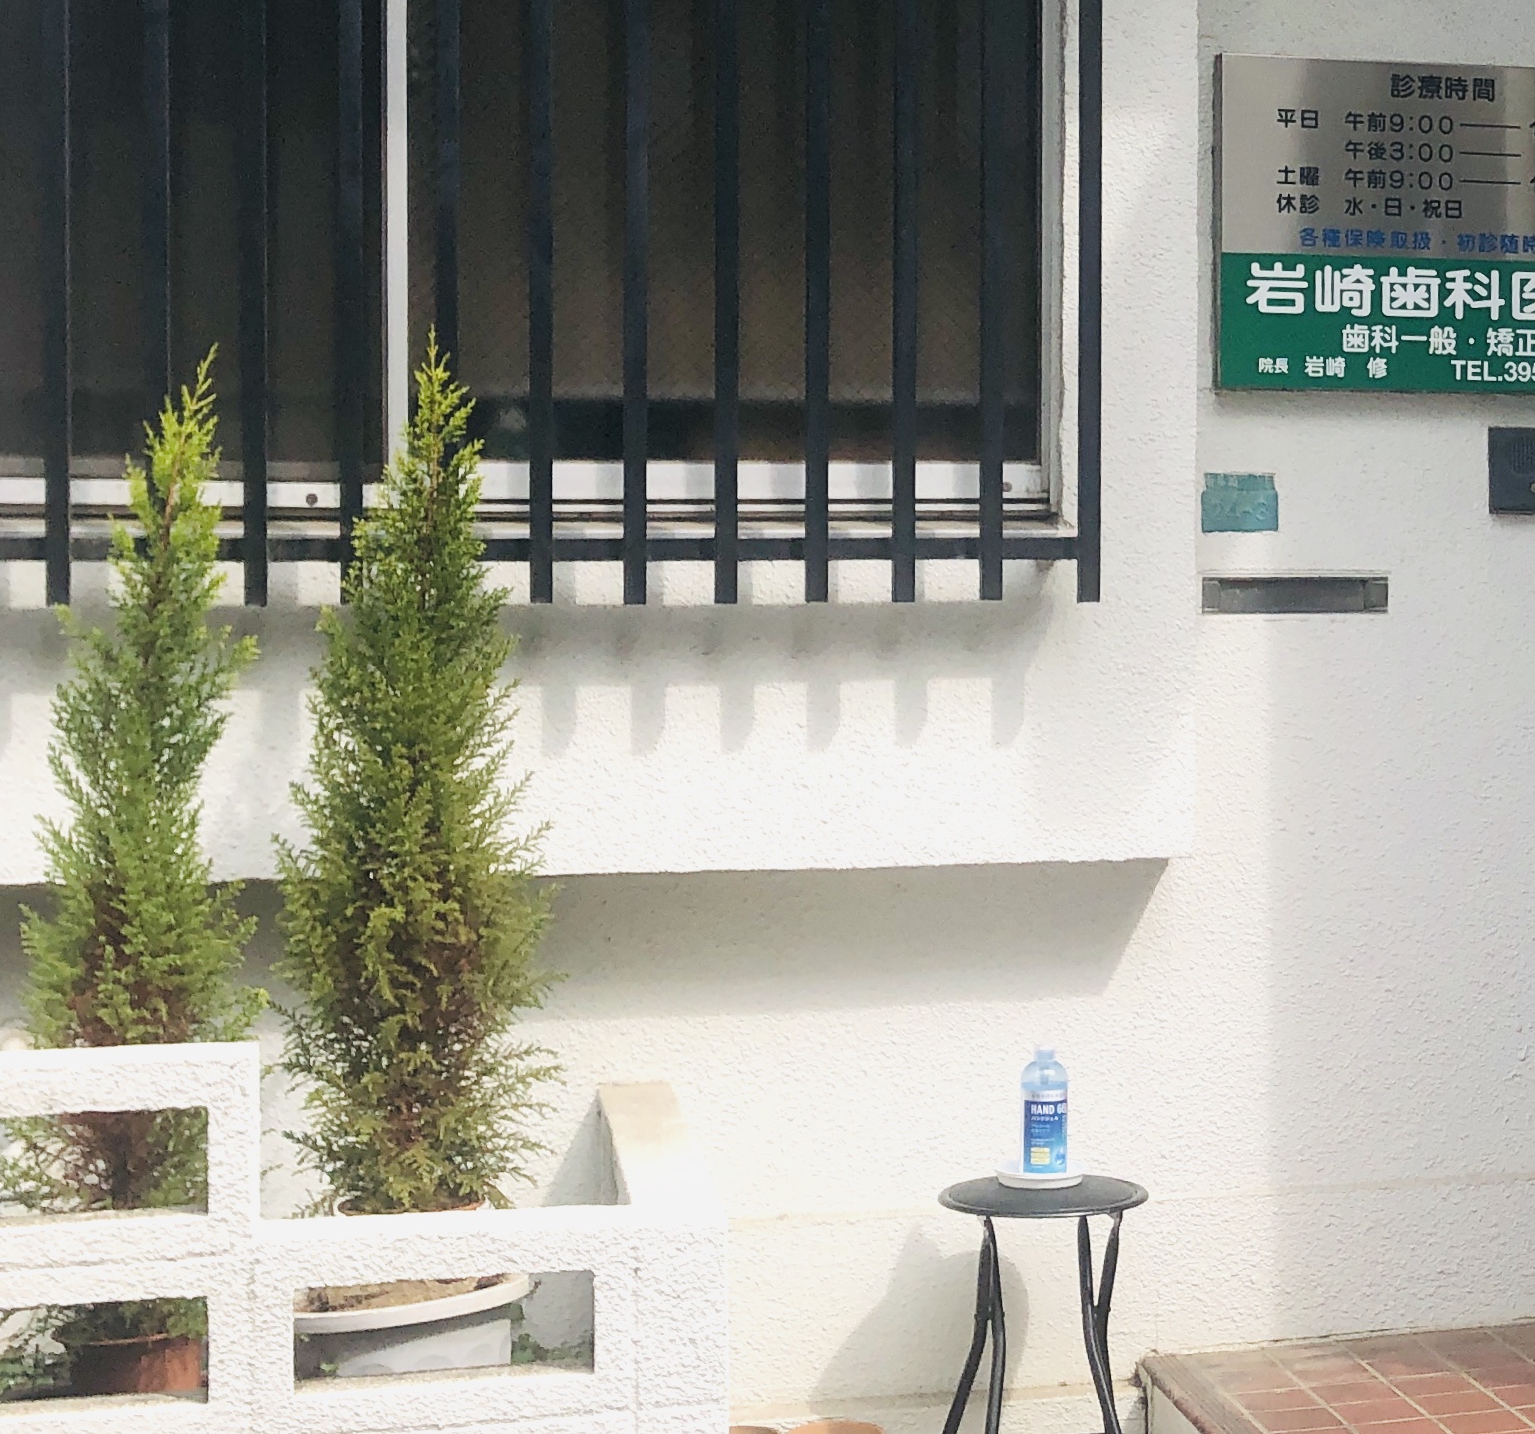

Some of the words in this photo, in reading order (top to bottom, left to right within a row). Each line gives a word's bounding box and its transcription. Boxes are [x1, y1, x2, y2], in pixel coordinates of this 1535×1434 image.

[1390, 73, 1496, 102] 診療時間
[1276, 108, 1319, 129] 平日
[1276, 165, 1320, 187] 土曜
[1276, 193, 1320, 215] 休診
[1258, 357, 1289, 374] 院長
[1304, 355, 1346, 378] 岩崎
[1366, 356, 1388, 379] 修
[1030, 1103, 1055, 1115] HAND
